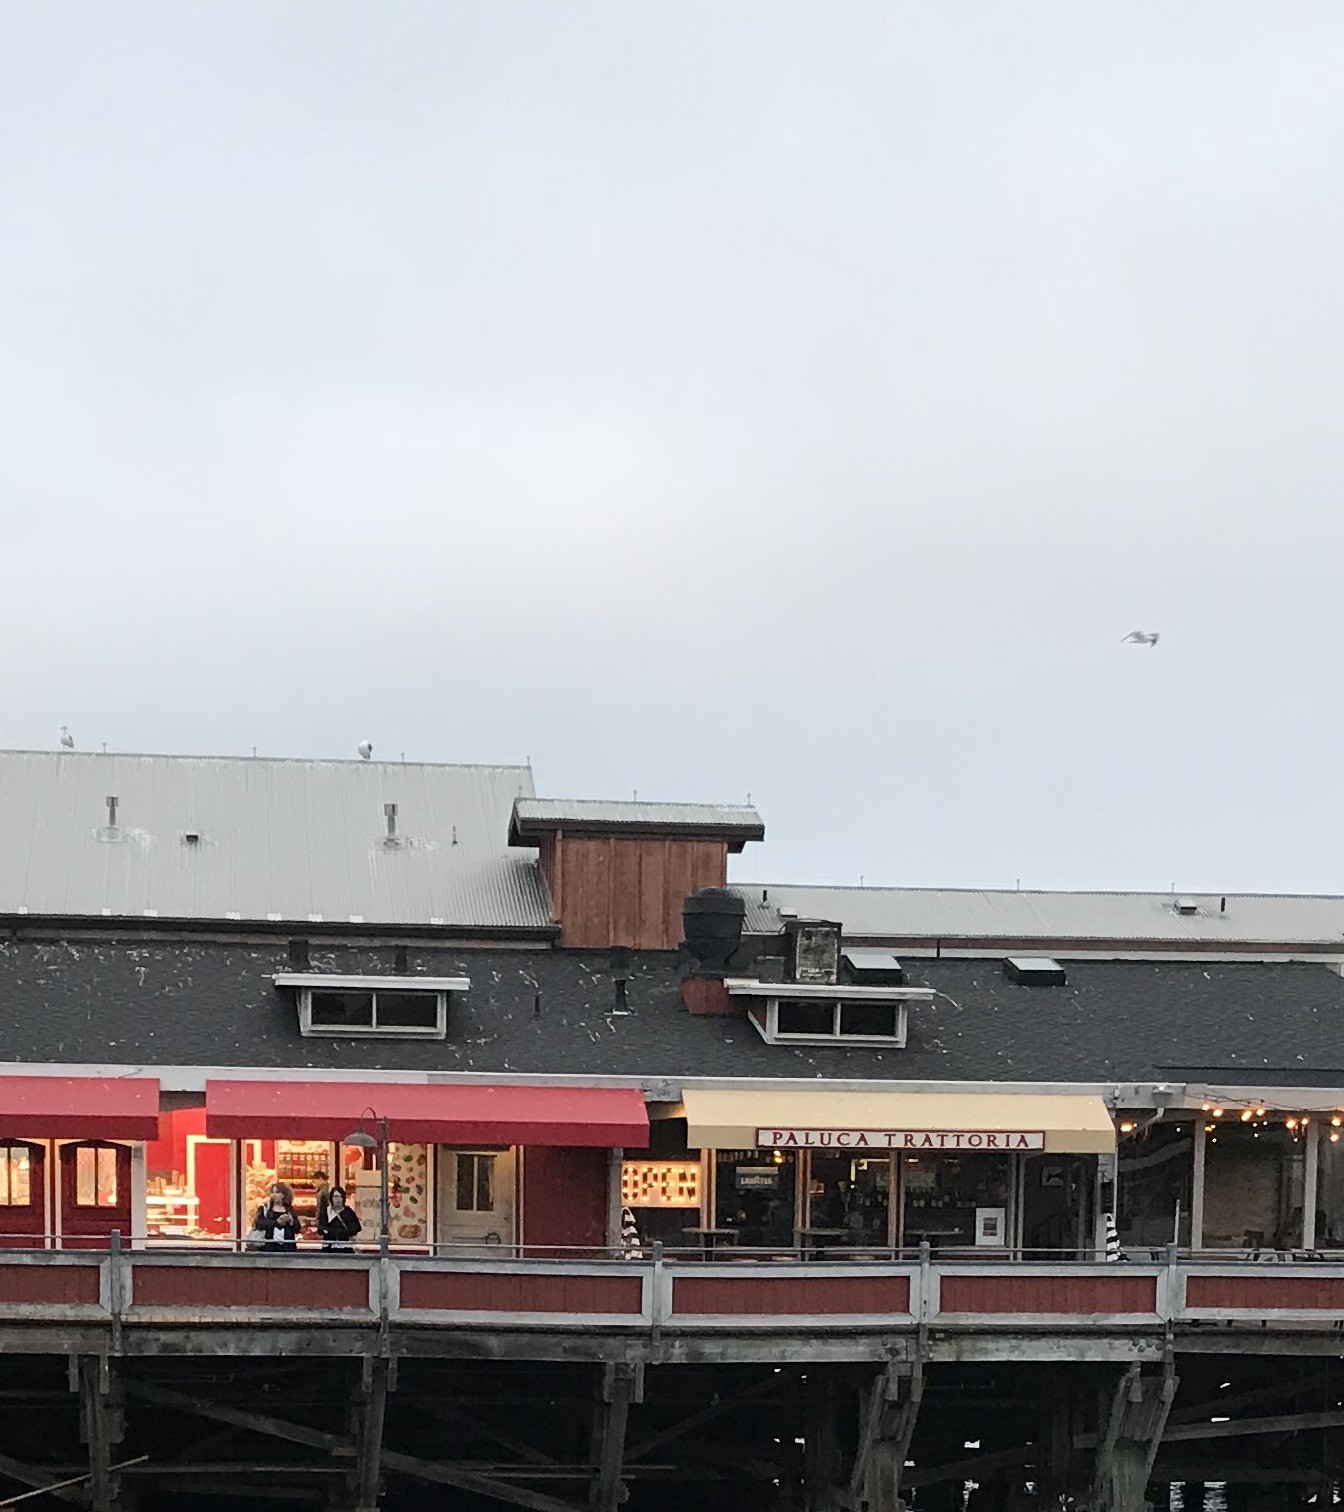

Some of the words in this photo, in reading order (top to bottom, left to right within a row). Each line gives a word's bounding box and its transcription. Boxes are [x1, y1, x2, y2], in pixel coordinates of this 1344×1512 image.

[772, 1131, 869, 1148] PALUCA
[884, 1132, 1030, 1148] TRATTORIA
[622, 1167, 697, 1201] OPEN
